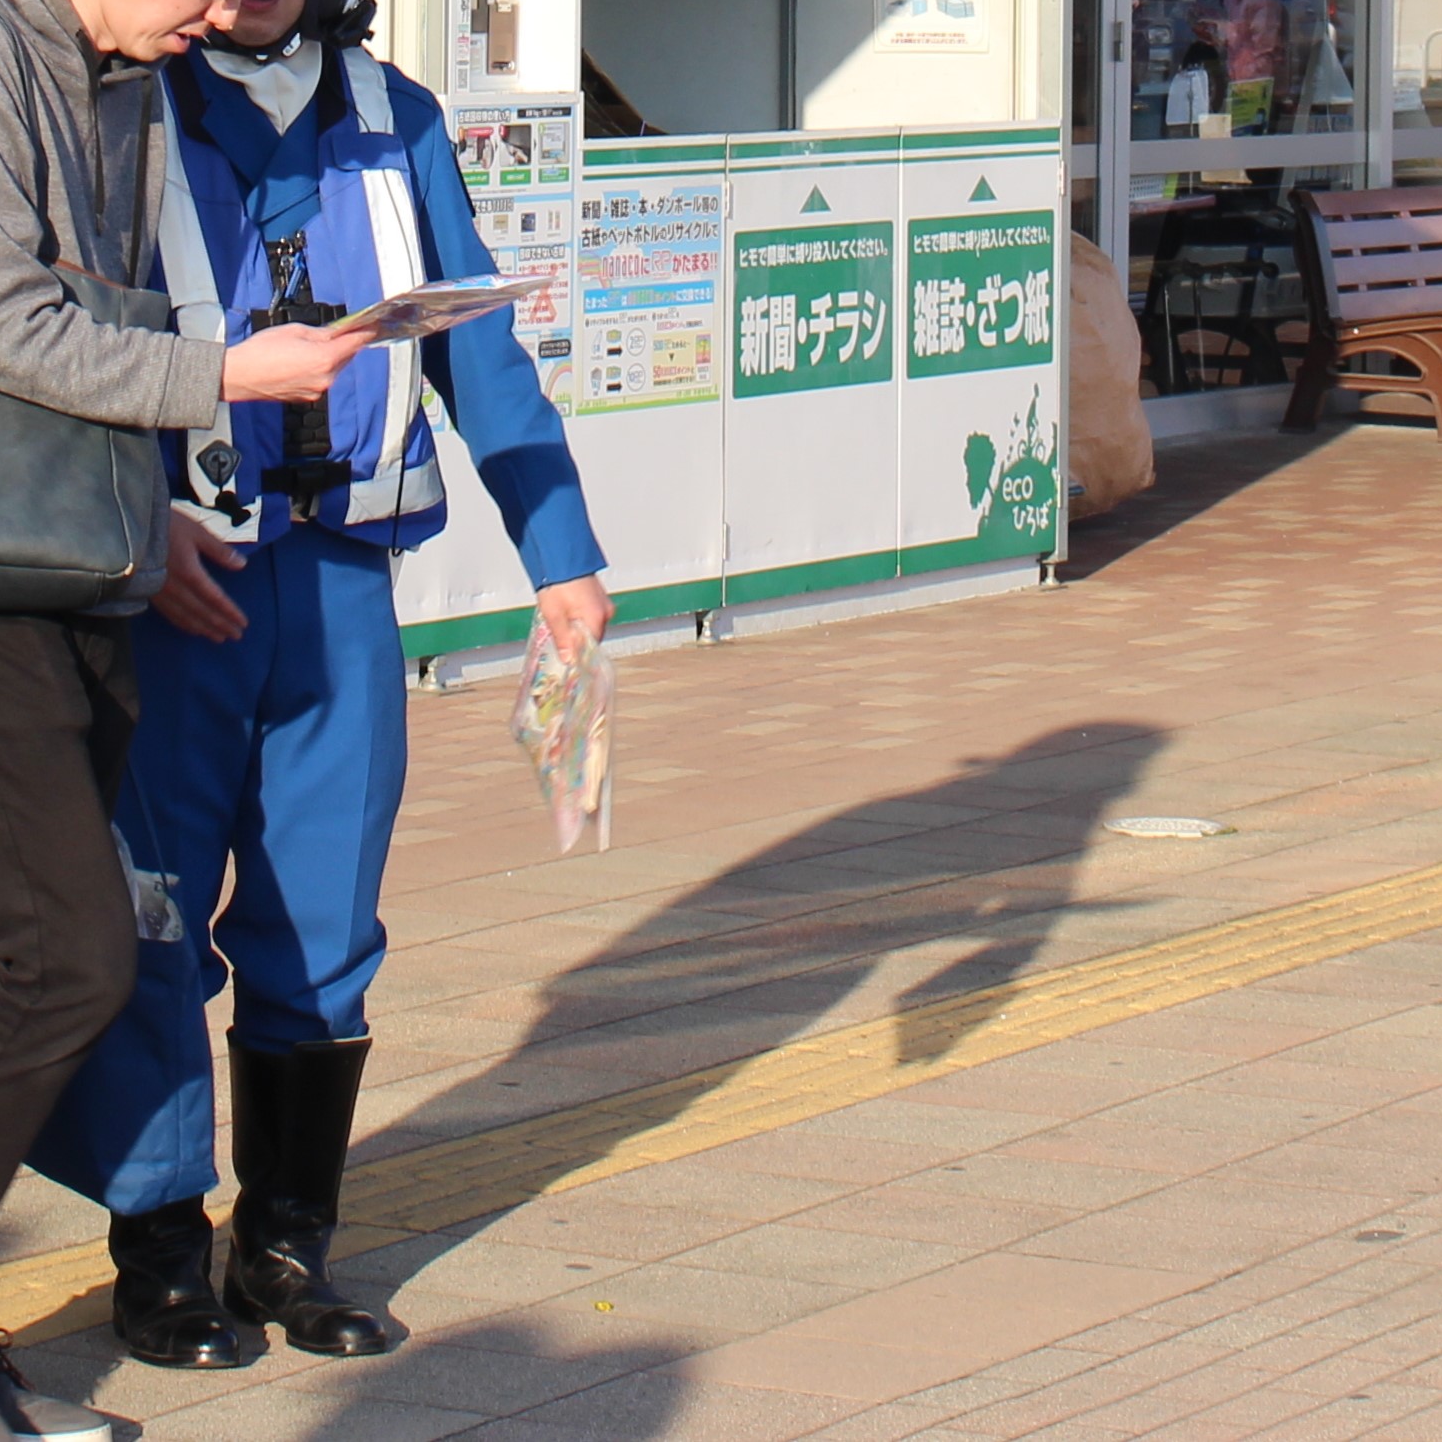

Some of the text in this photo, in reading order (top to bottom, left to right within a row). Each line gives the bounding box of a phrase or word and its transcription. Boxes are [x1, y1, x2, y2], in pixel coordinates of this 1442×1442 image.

[582, 196, 718, 220] 新聞・雑誌・本・ダンボール等の
[581, 222, 718, 248] 古紙やペットボトルのリサイクルで
[913, 225, 1050, 254] ヒモで簡単に縛り投入してください。
[740, 239, 888, 268] ヒモで簡単に縛り投入してください。
[914, 269, 1049, 357] 雑誌・ざつ紙
[740, 290, 886, 376] 新聞・チラシ
[1002, 475, 1034, 502] eco
[1012, 498, 1052, 537] ひろば
